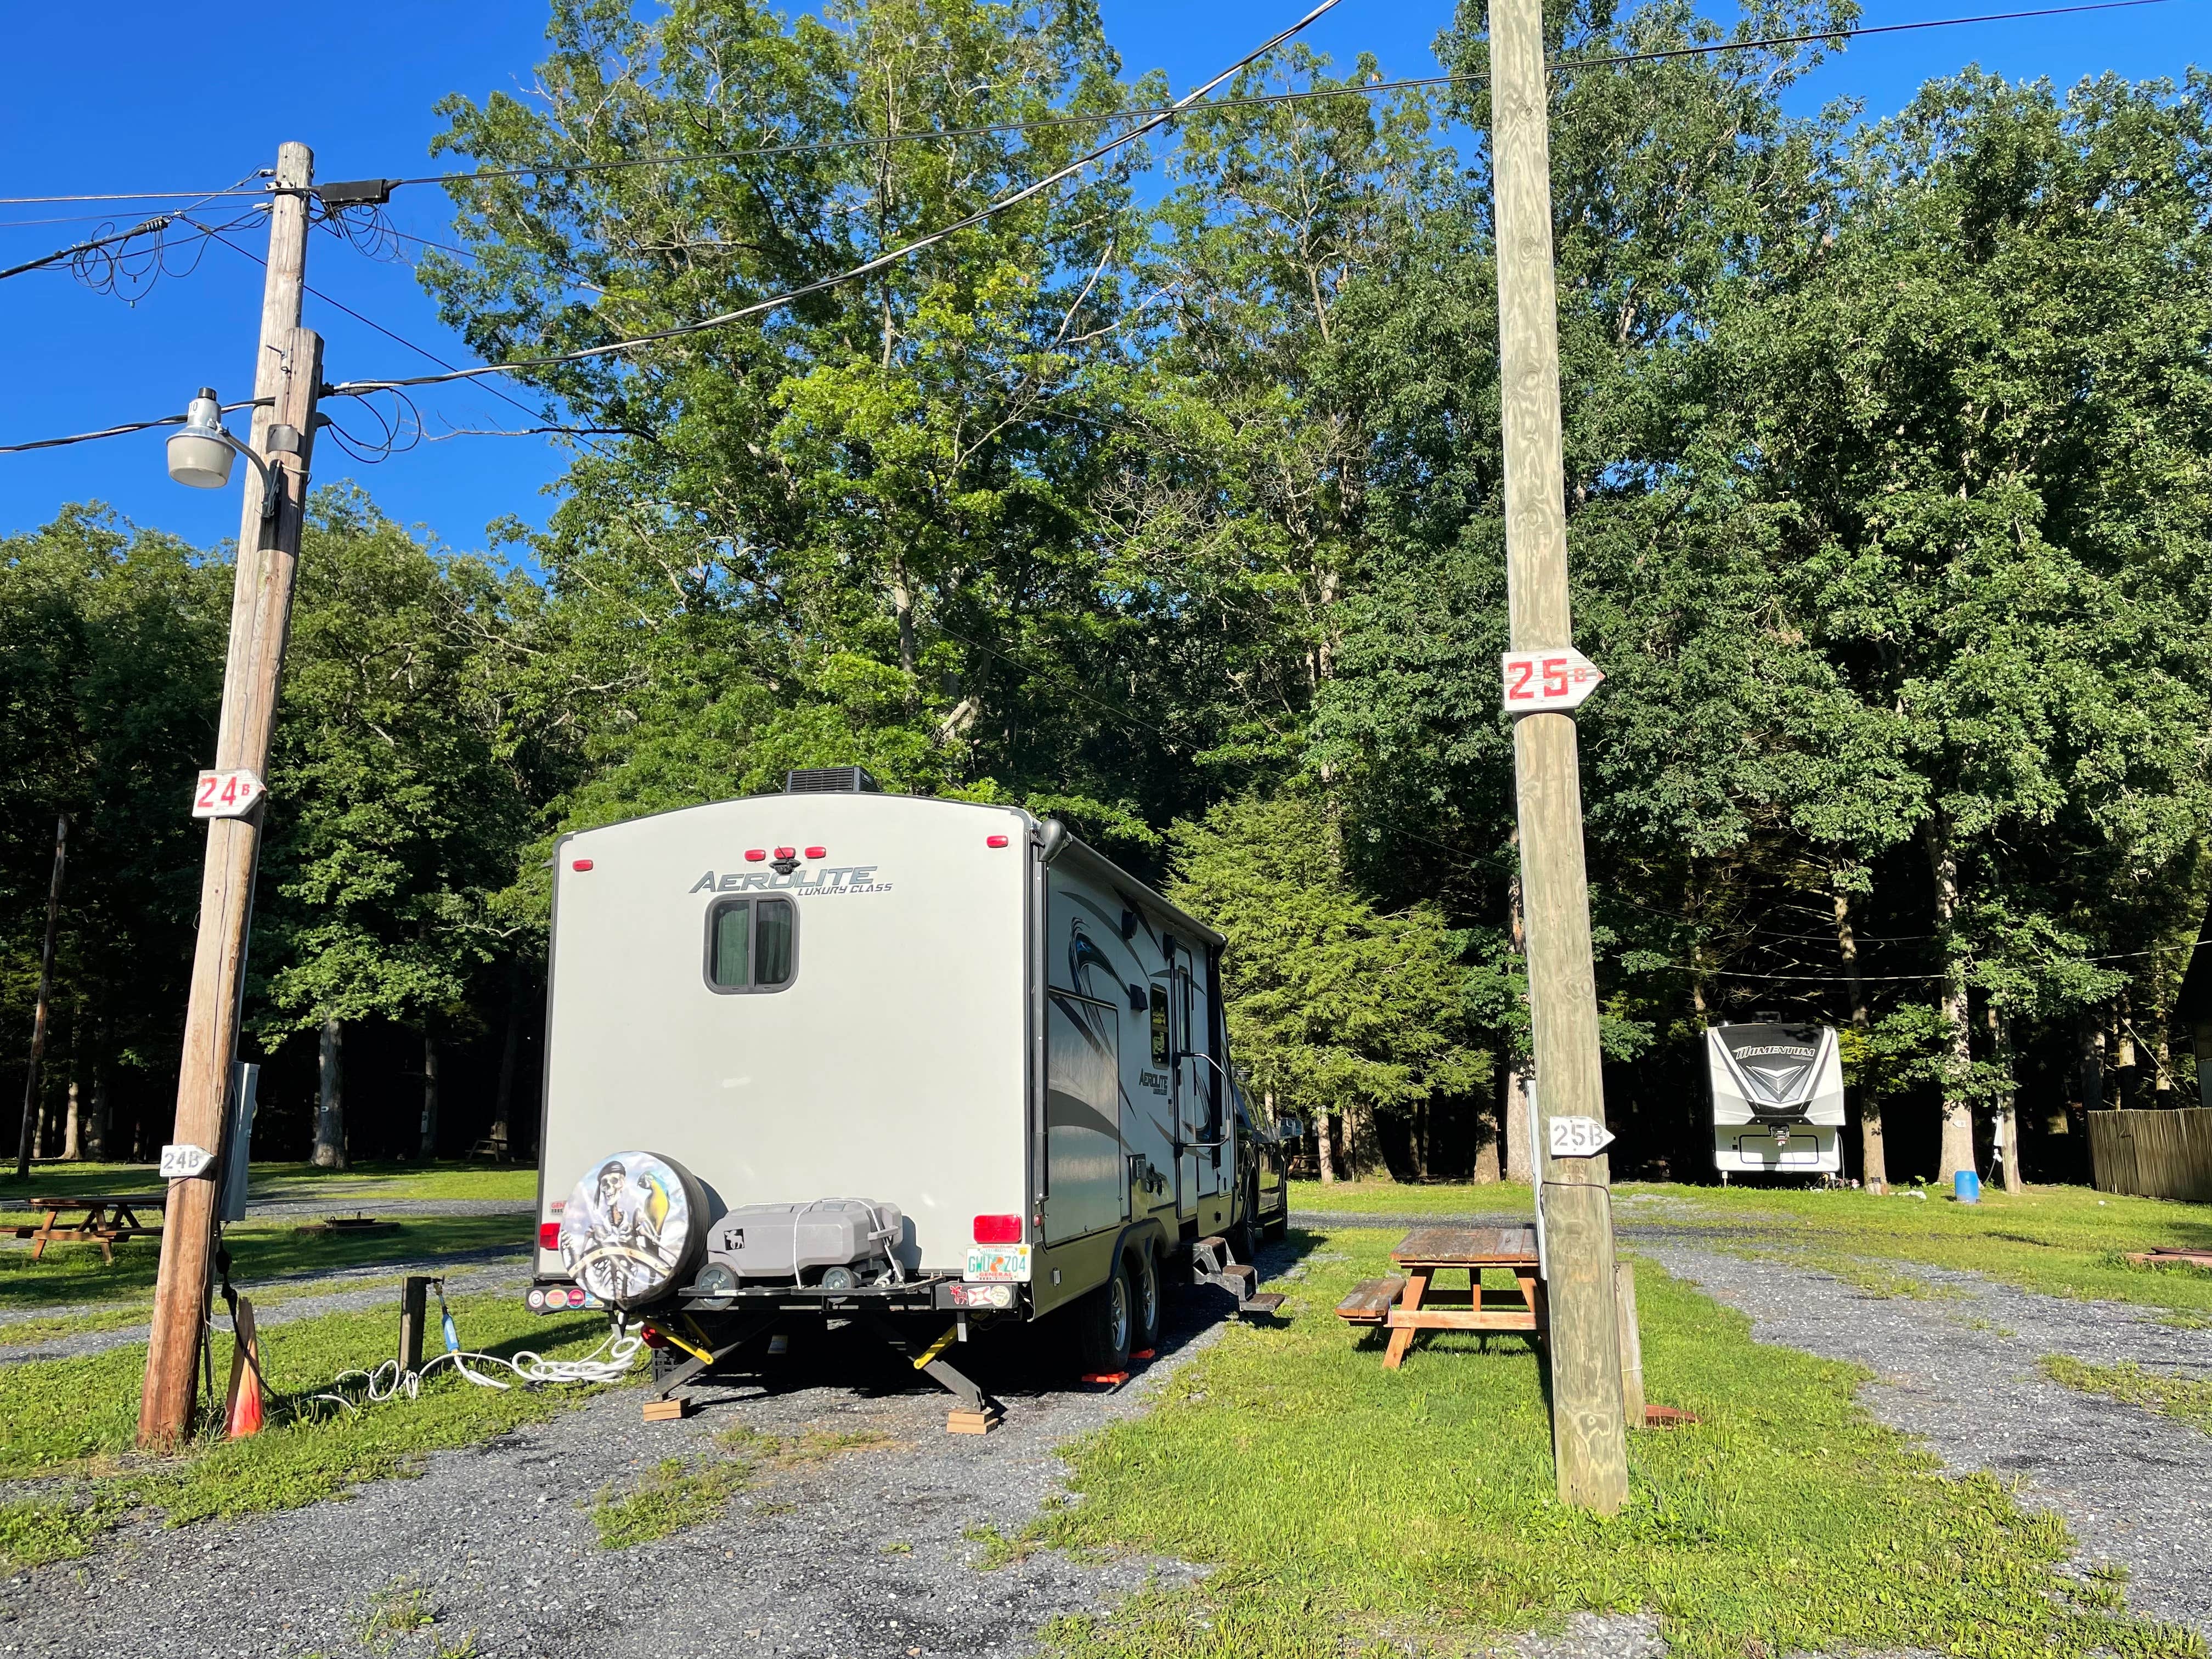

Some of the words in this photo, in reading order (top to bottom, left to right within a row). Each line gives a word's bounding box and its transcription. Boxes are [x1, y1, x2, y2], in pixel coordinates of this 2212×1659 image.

[689, 866, 878, 893] AEROLITE
[798, 885, 848, 896] LUXURY
[849, 883, 893, 894] CLASS
[1732, 1045, 1816, 1060] MOMENTUM
[1554, 1123, 1604, 1146] 25B
[163, 1150, 201, 1170] 24B
